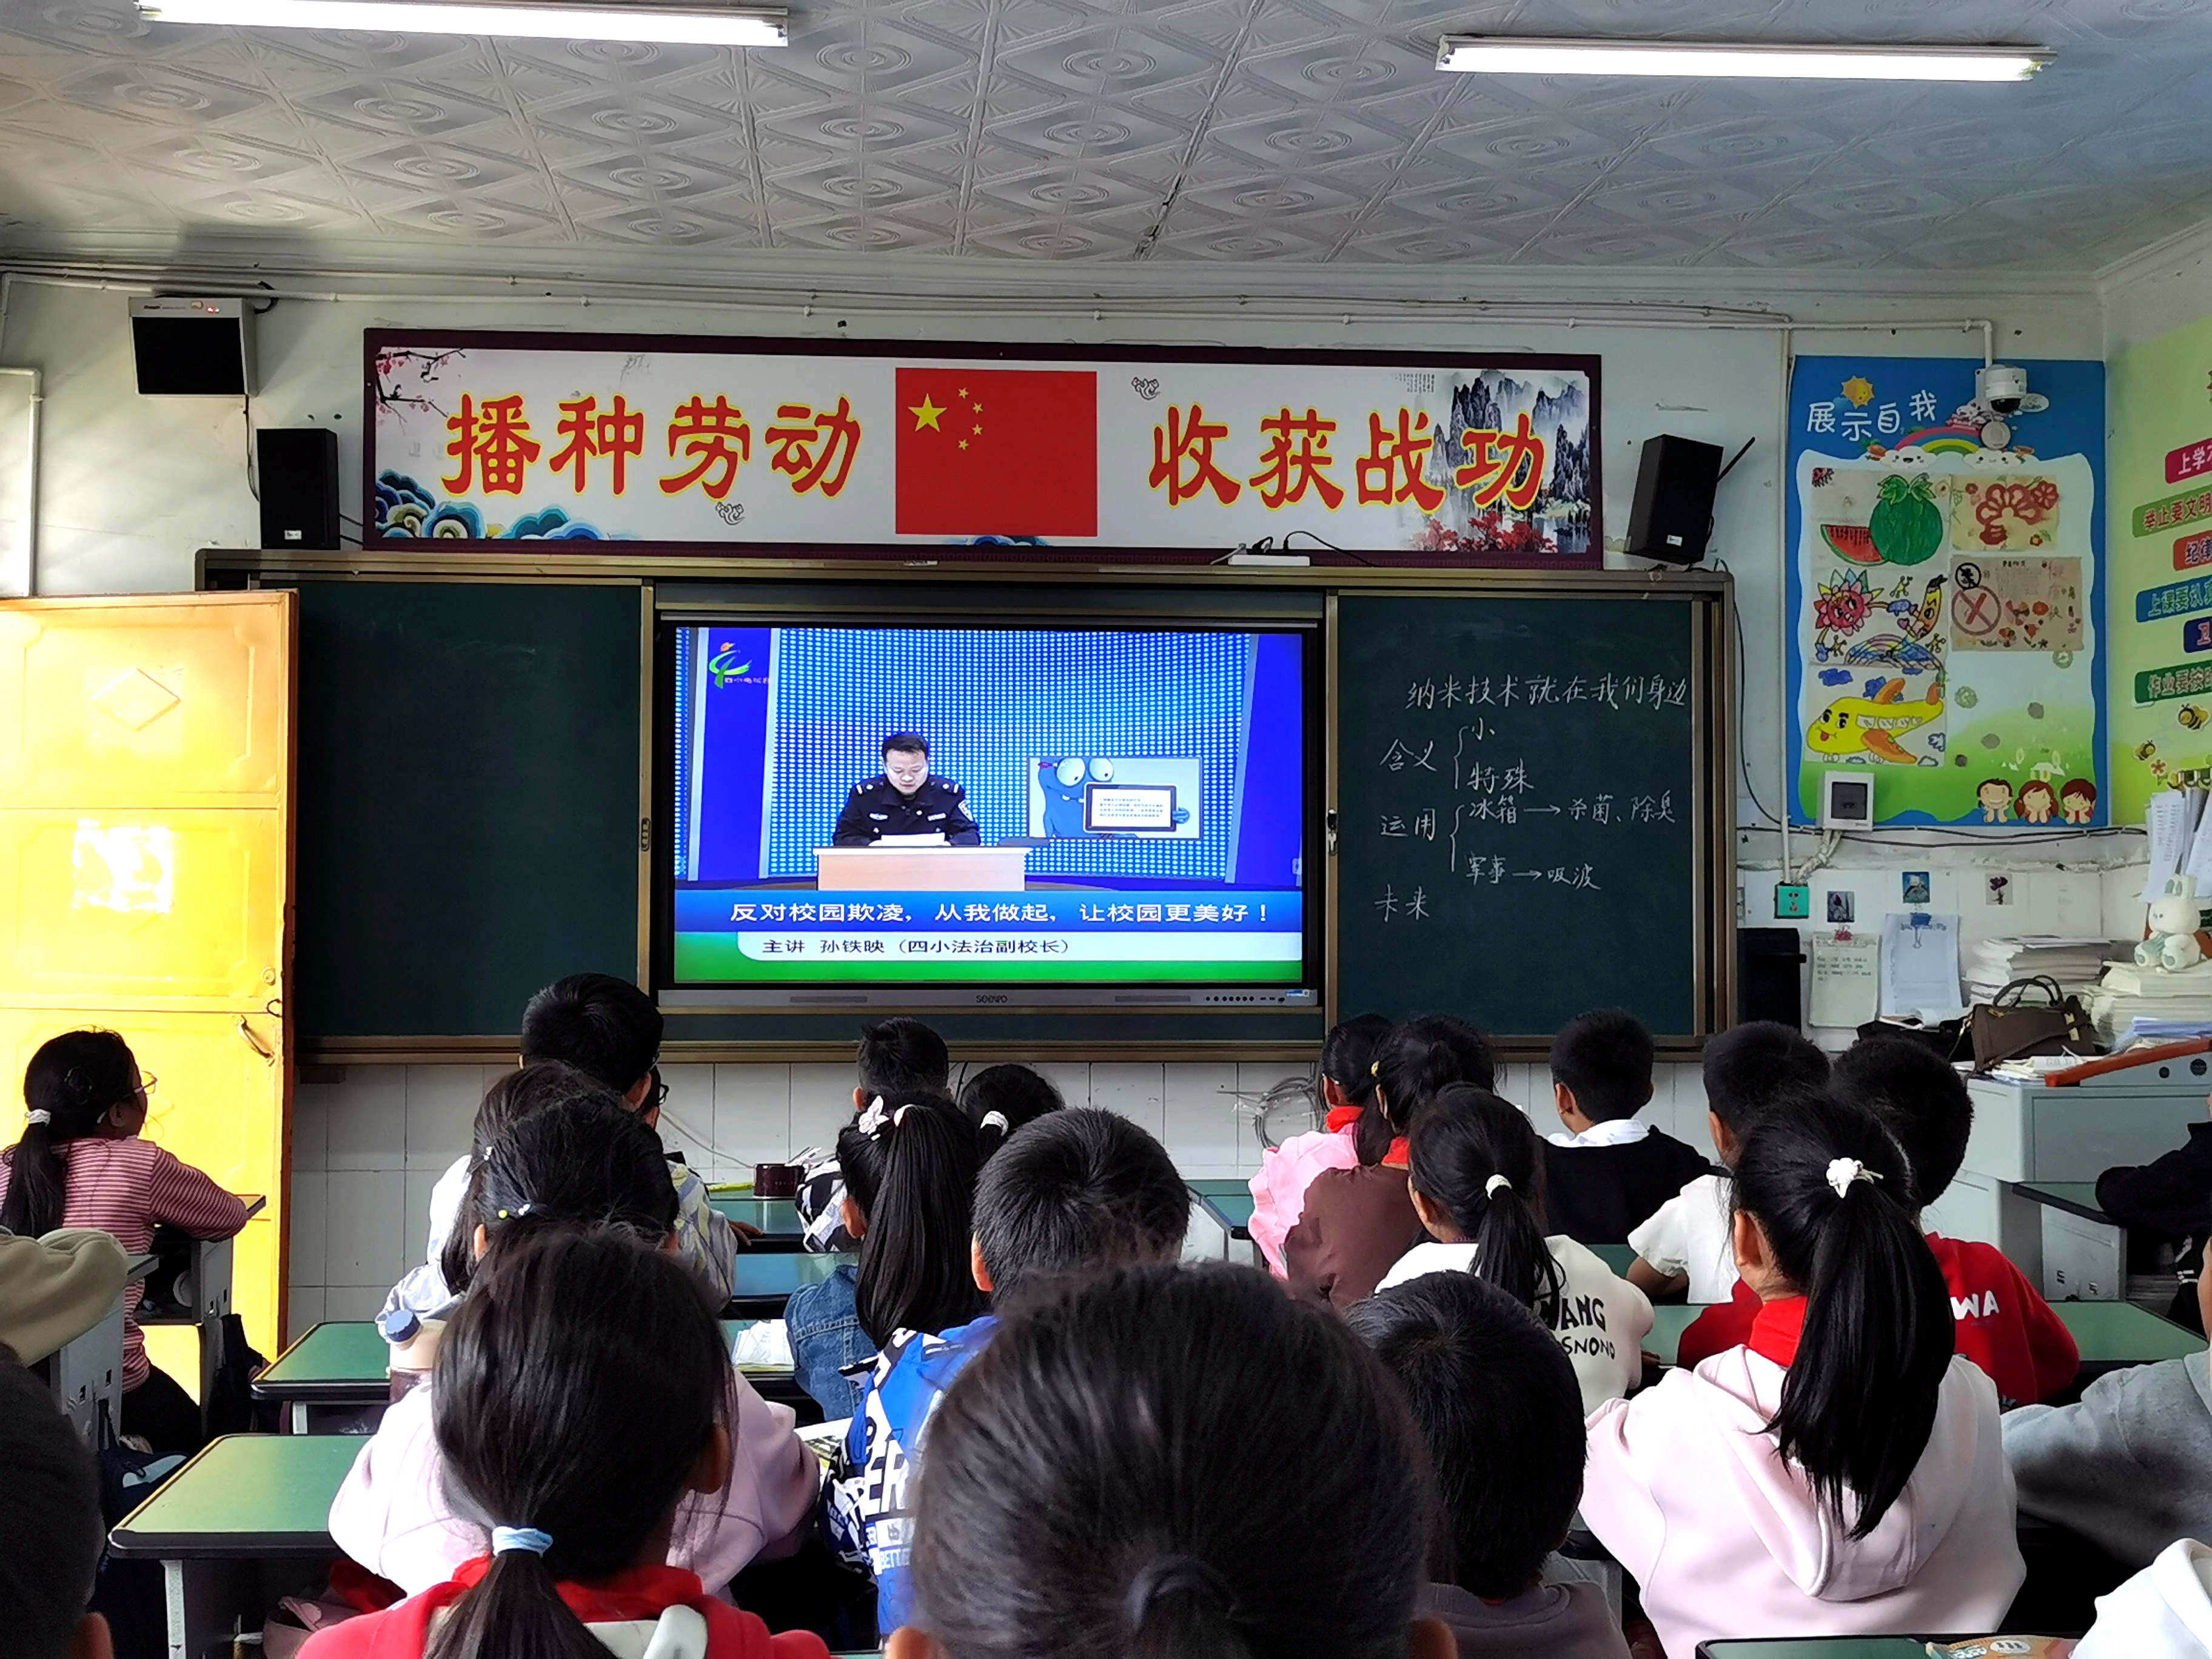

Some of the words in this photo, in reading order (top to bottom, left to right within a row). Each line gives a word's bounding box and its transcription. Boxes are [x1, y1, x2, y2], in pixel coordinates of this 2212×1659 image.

[1807, 389, 1937, 441] 展示自我
[441, 391, 862, 501] 播种劳动
[1148, 403, 1545, 513] 收获战功
[1405, 672, 1687, 711] 纳米技术就在我们身边
[1471, 717, 1496, 741] 小
[1379, 738, 1438, 772] 含义
[1466, 757, 1535, 794] 特殊
[1380, 808, 1436, 842] 运用
[1469, 794, 1518, 825] 冰箱
[1465, 850, 1507, 885] 军事
[1546, 862, 1602, 891] 吸波
[1374, 883, 1430, 923] 未来
[762, 939, 806, 954] 主讲
